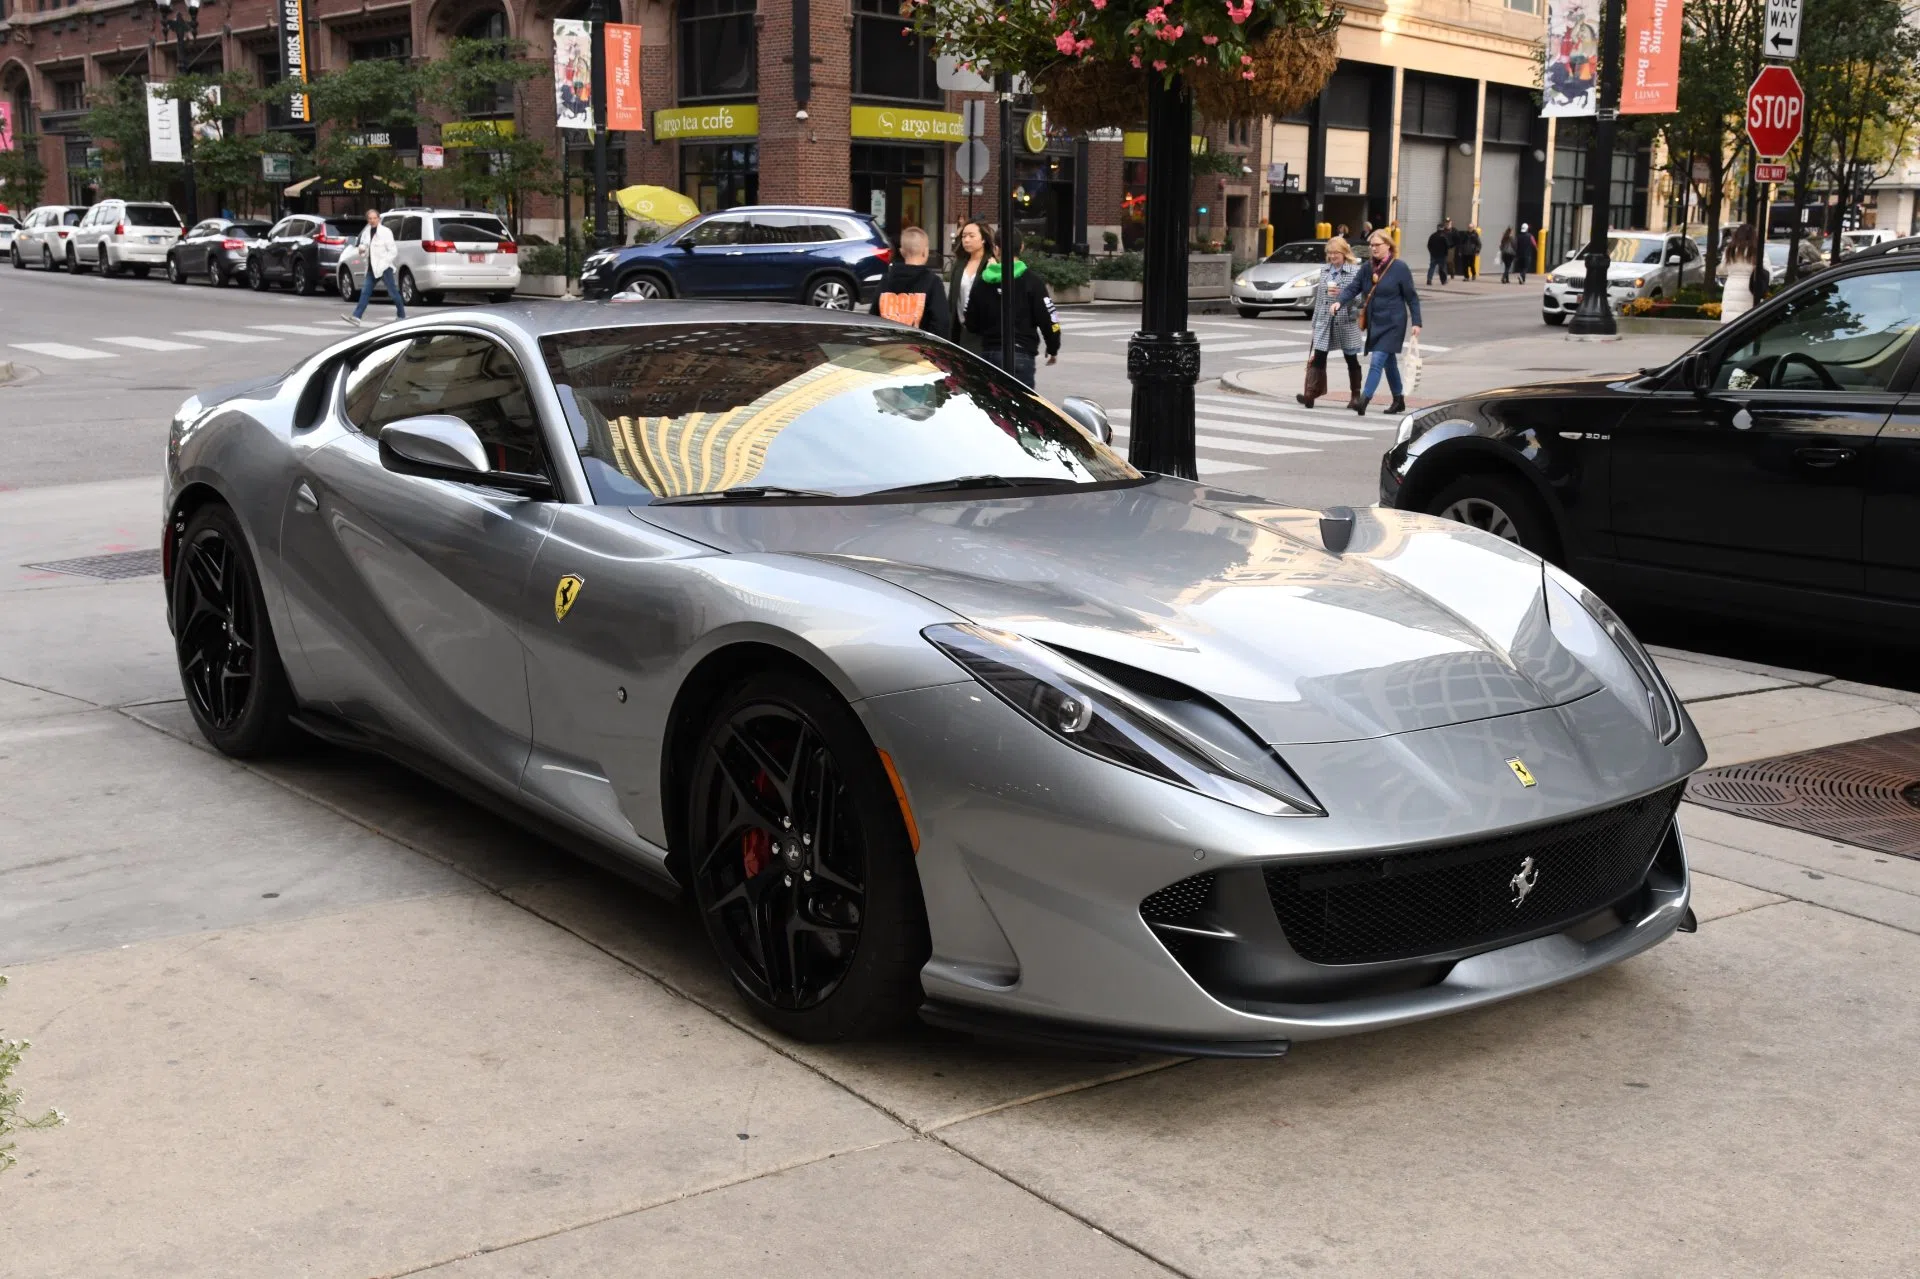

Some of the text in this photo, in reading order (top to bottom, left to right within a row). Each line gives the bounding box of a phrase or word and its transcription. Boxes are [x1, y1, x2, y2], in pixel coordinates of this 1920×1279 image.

[1770, 11, 1797, 28] WAY
[622, 31, 632, 86] Following
[1636, 30, 1651, 87] the Box
[289, 67, 305, 119] EINSN
[615, 67, 625, 110] the Box
[1634, 90, 1660, 100] LUMA
[663, 107, 734, 136] argo tea café
[1750, 94, 1800, 129] STOP
[901, 118, 930, 138] argo
[933, 118, 947, 134] tea
[1758, 167, 1784, 179] ALL WAY
